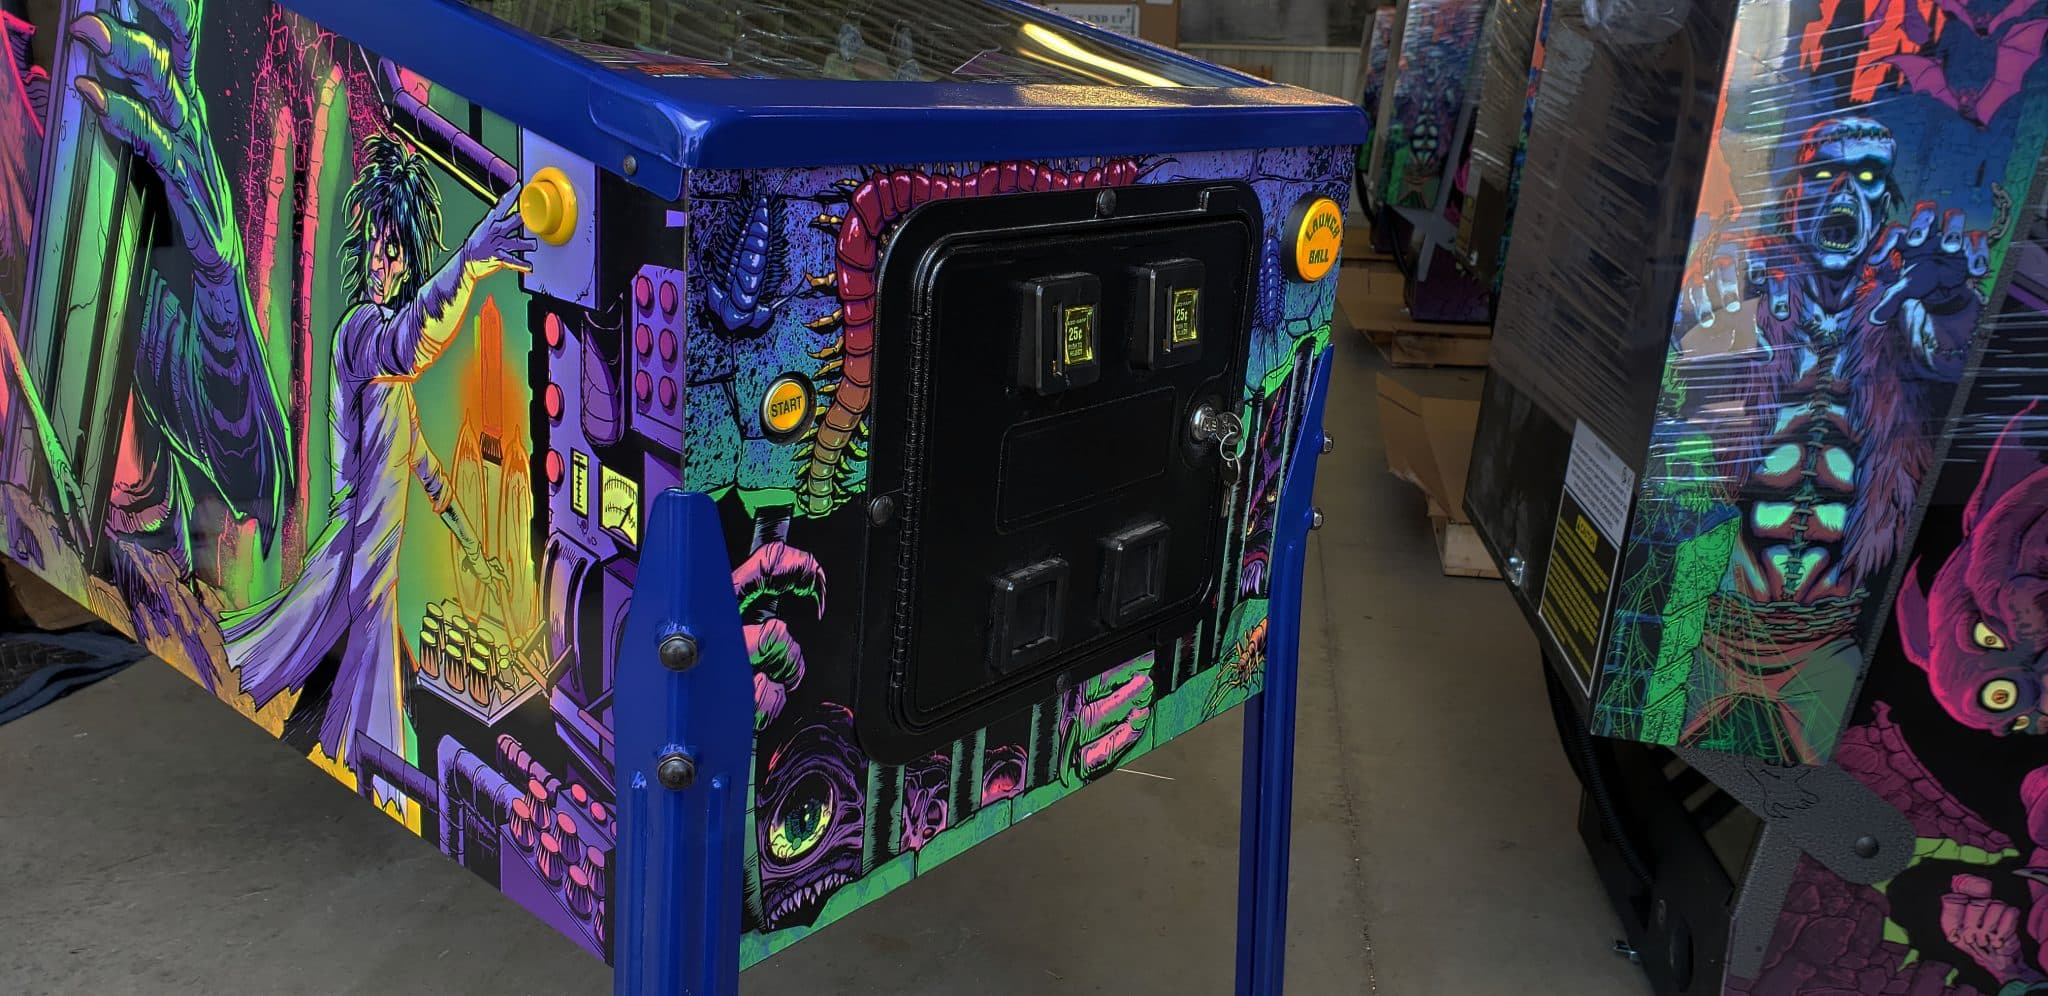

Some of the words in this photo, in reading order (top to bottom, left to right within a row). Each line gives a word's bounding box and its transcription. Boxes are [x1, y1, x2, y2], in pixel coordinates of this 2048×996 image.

[1306, 213, 1340, 241] LAUNCH
[1308, 249, 1328, 264] BALL
[771, 396, 802, 418] START
